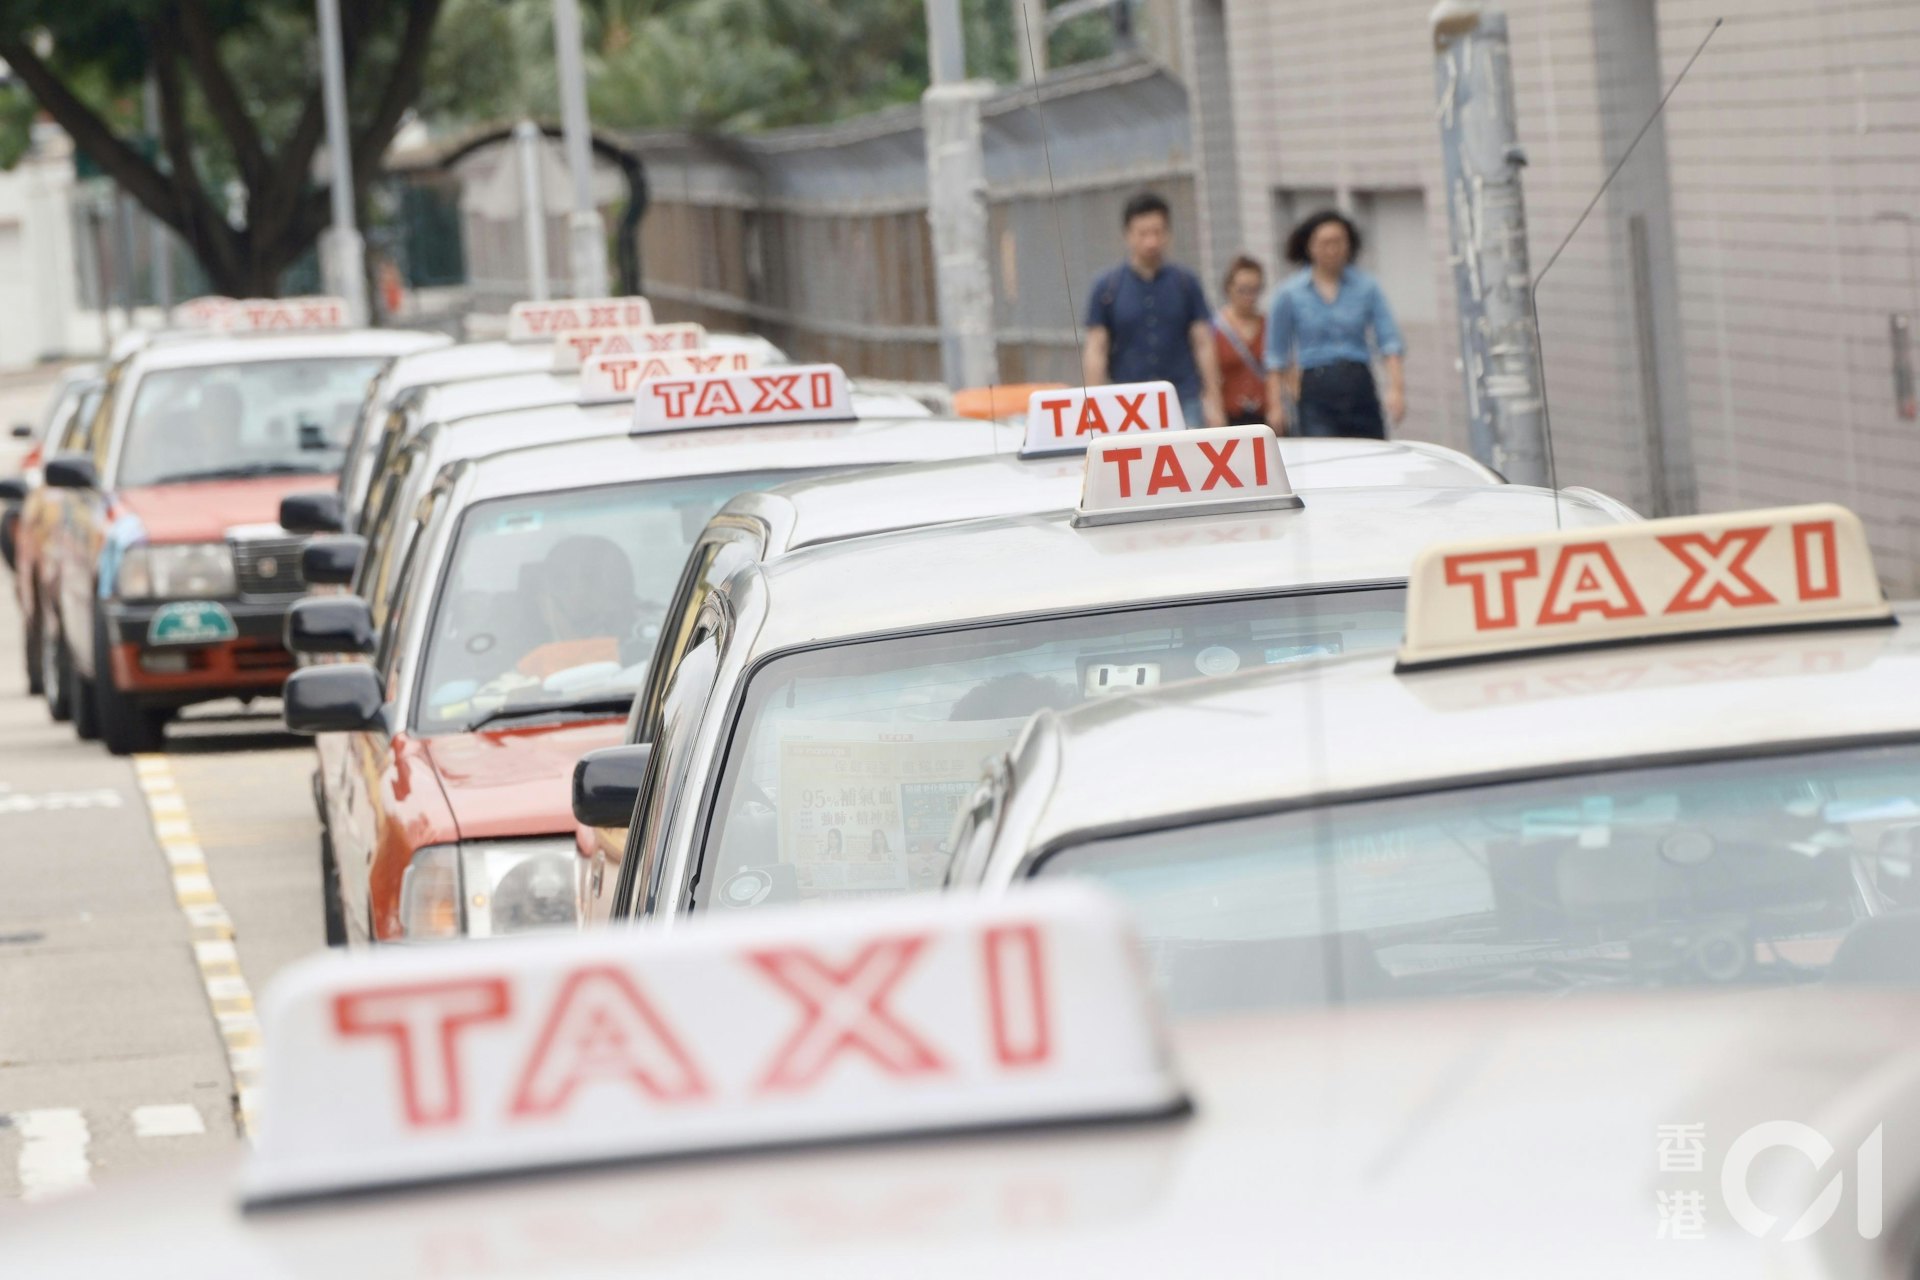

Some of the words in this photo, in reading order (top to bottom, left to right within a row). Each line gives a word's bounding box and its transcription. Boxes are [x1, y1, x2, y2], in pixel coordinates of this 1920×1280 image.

[246, 307, 341, 330] TAXI
[520, 305, 641, 332] TAXI
[653, 372, 832, 418] TAXI
[1041, 392, 1170, 437] TAXI
[1103, 437, 1268, 498] TAXI
[1443, 520, 1840, 631] TAXI
[333, 922, 1054, 1127] TAXI
